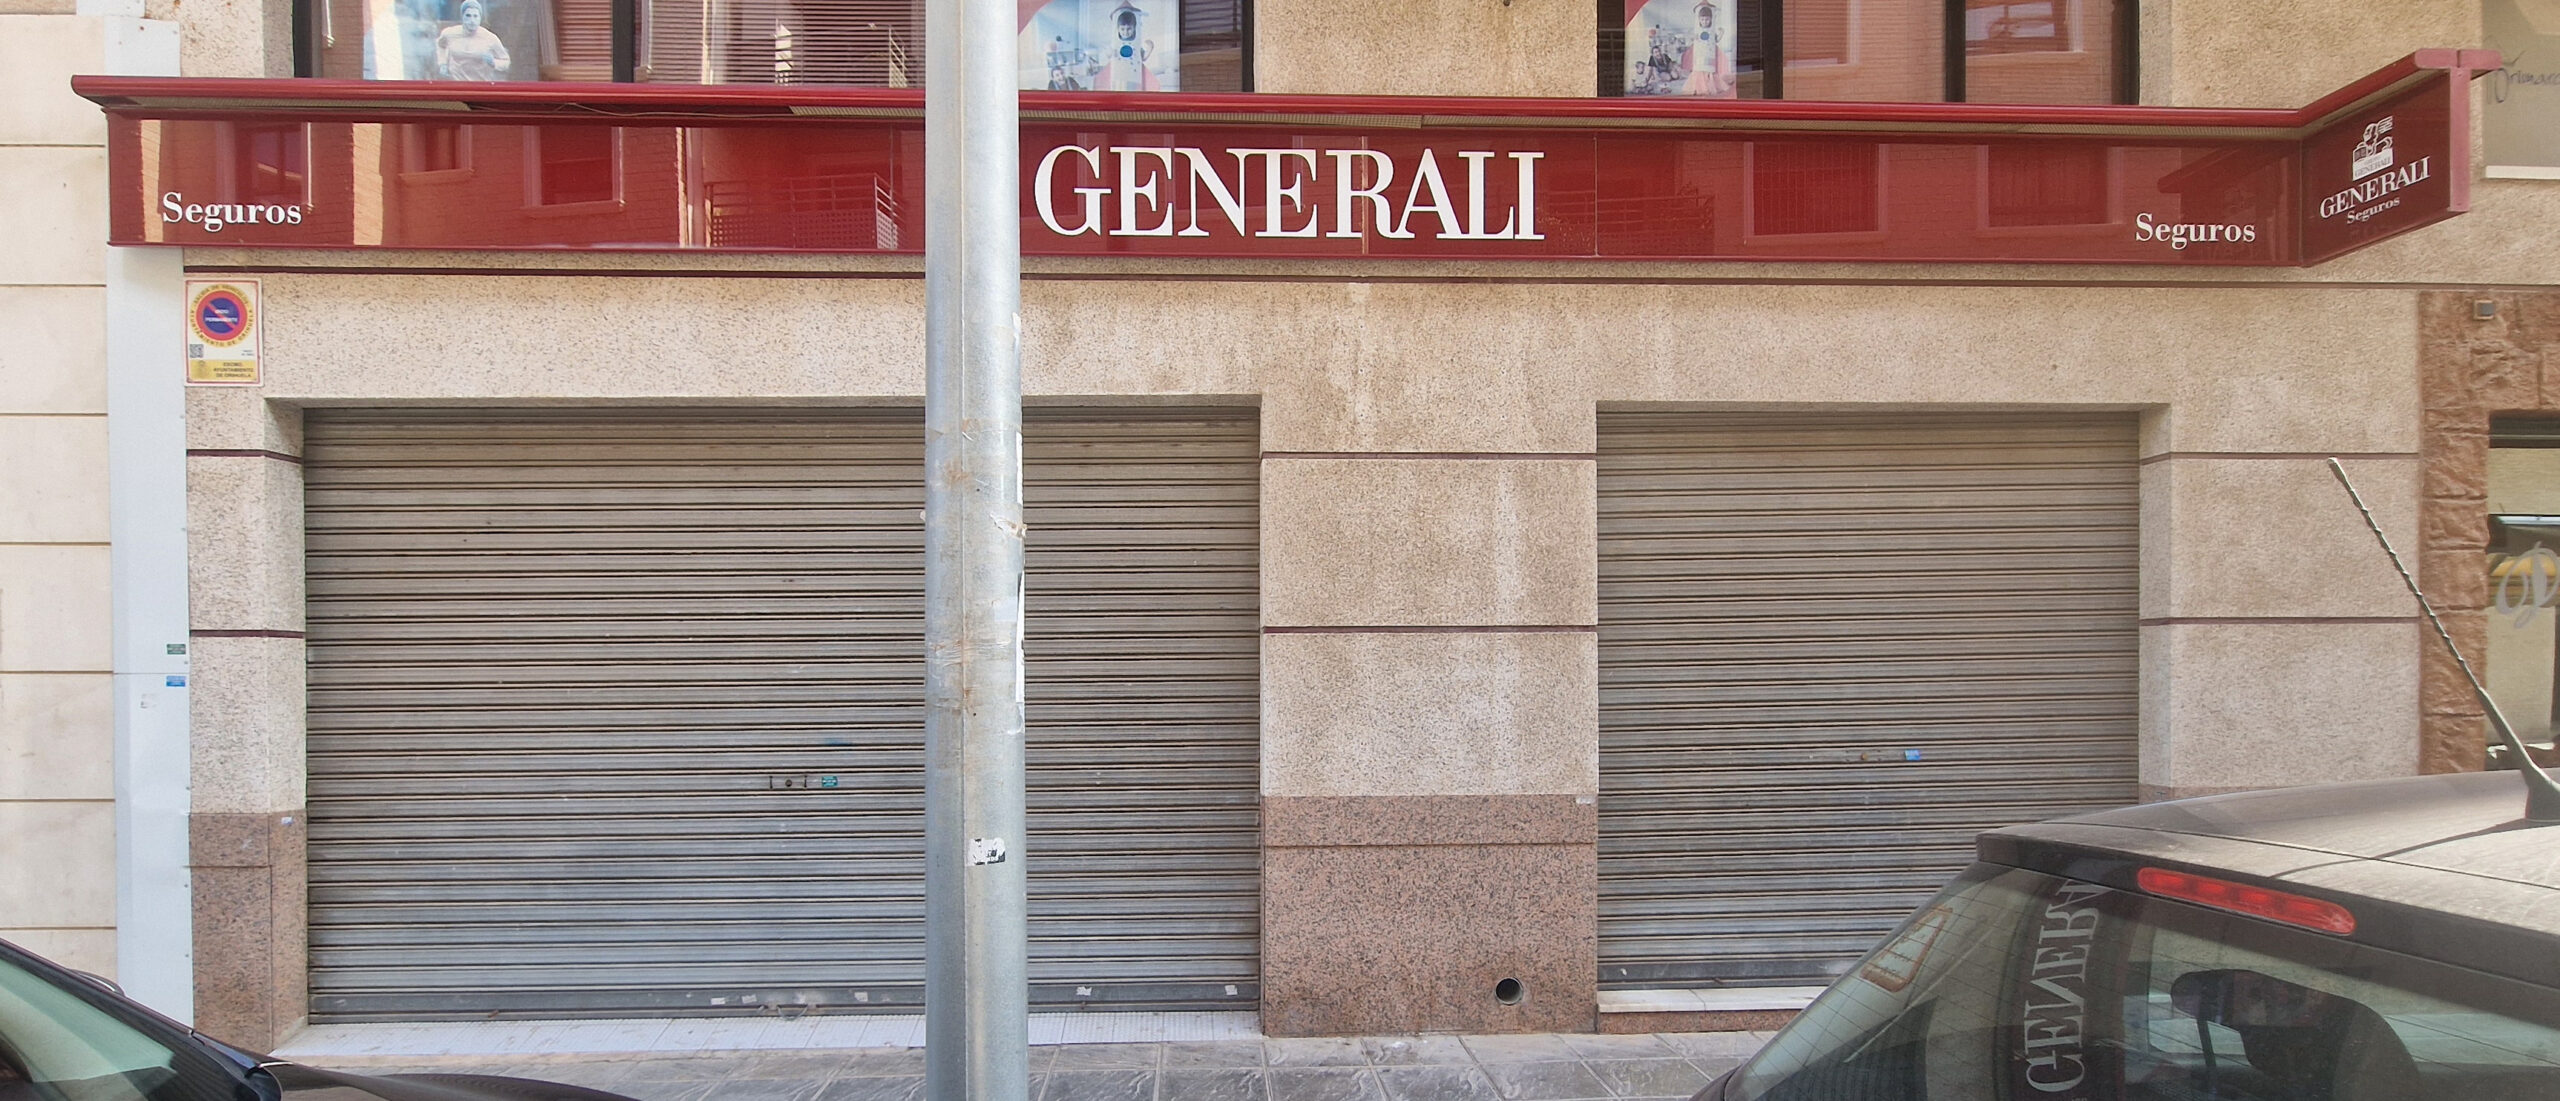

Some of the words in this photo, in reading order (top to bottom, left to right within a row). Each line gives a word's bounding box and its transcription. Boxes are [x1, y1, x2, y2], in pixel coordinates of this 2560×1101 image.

[1035, 146, 1544, 240] GENERALI
[2320, 155, 2431, 218] GENERALI
[162, 192, 303, 231] Seguros
[2347, 197, 2400, 224] Seguros
[2136, 213, 2256, 250] Seguros
